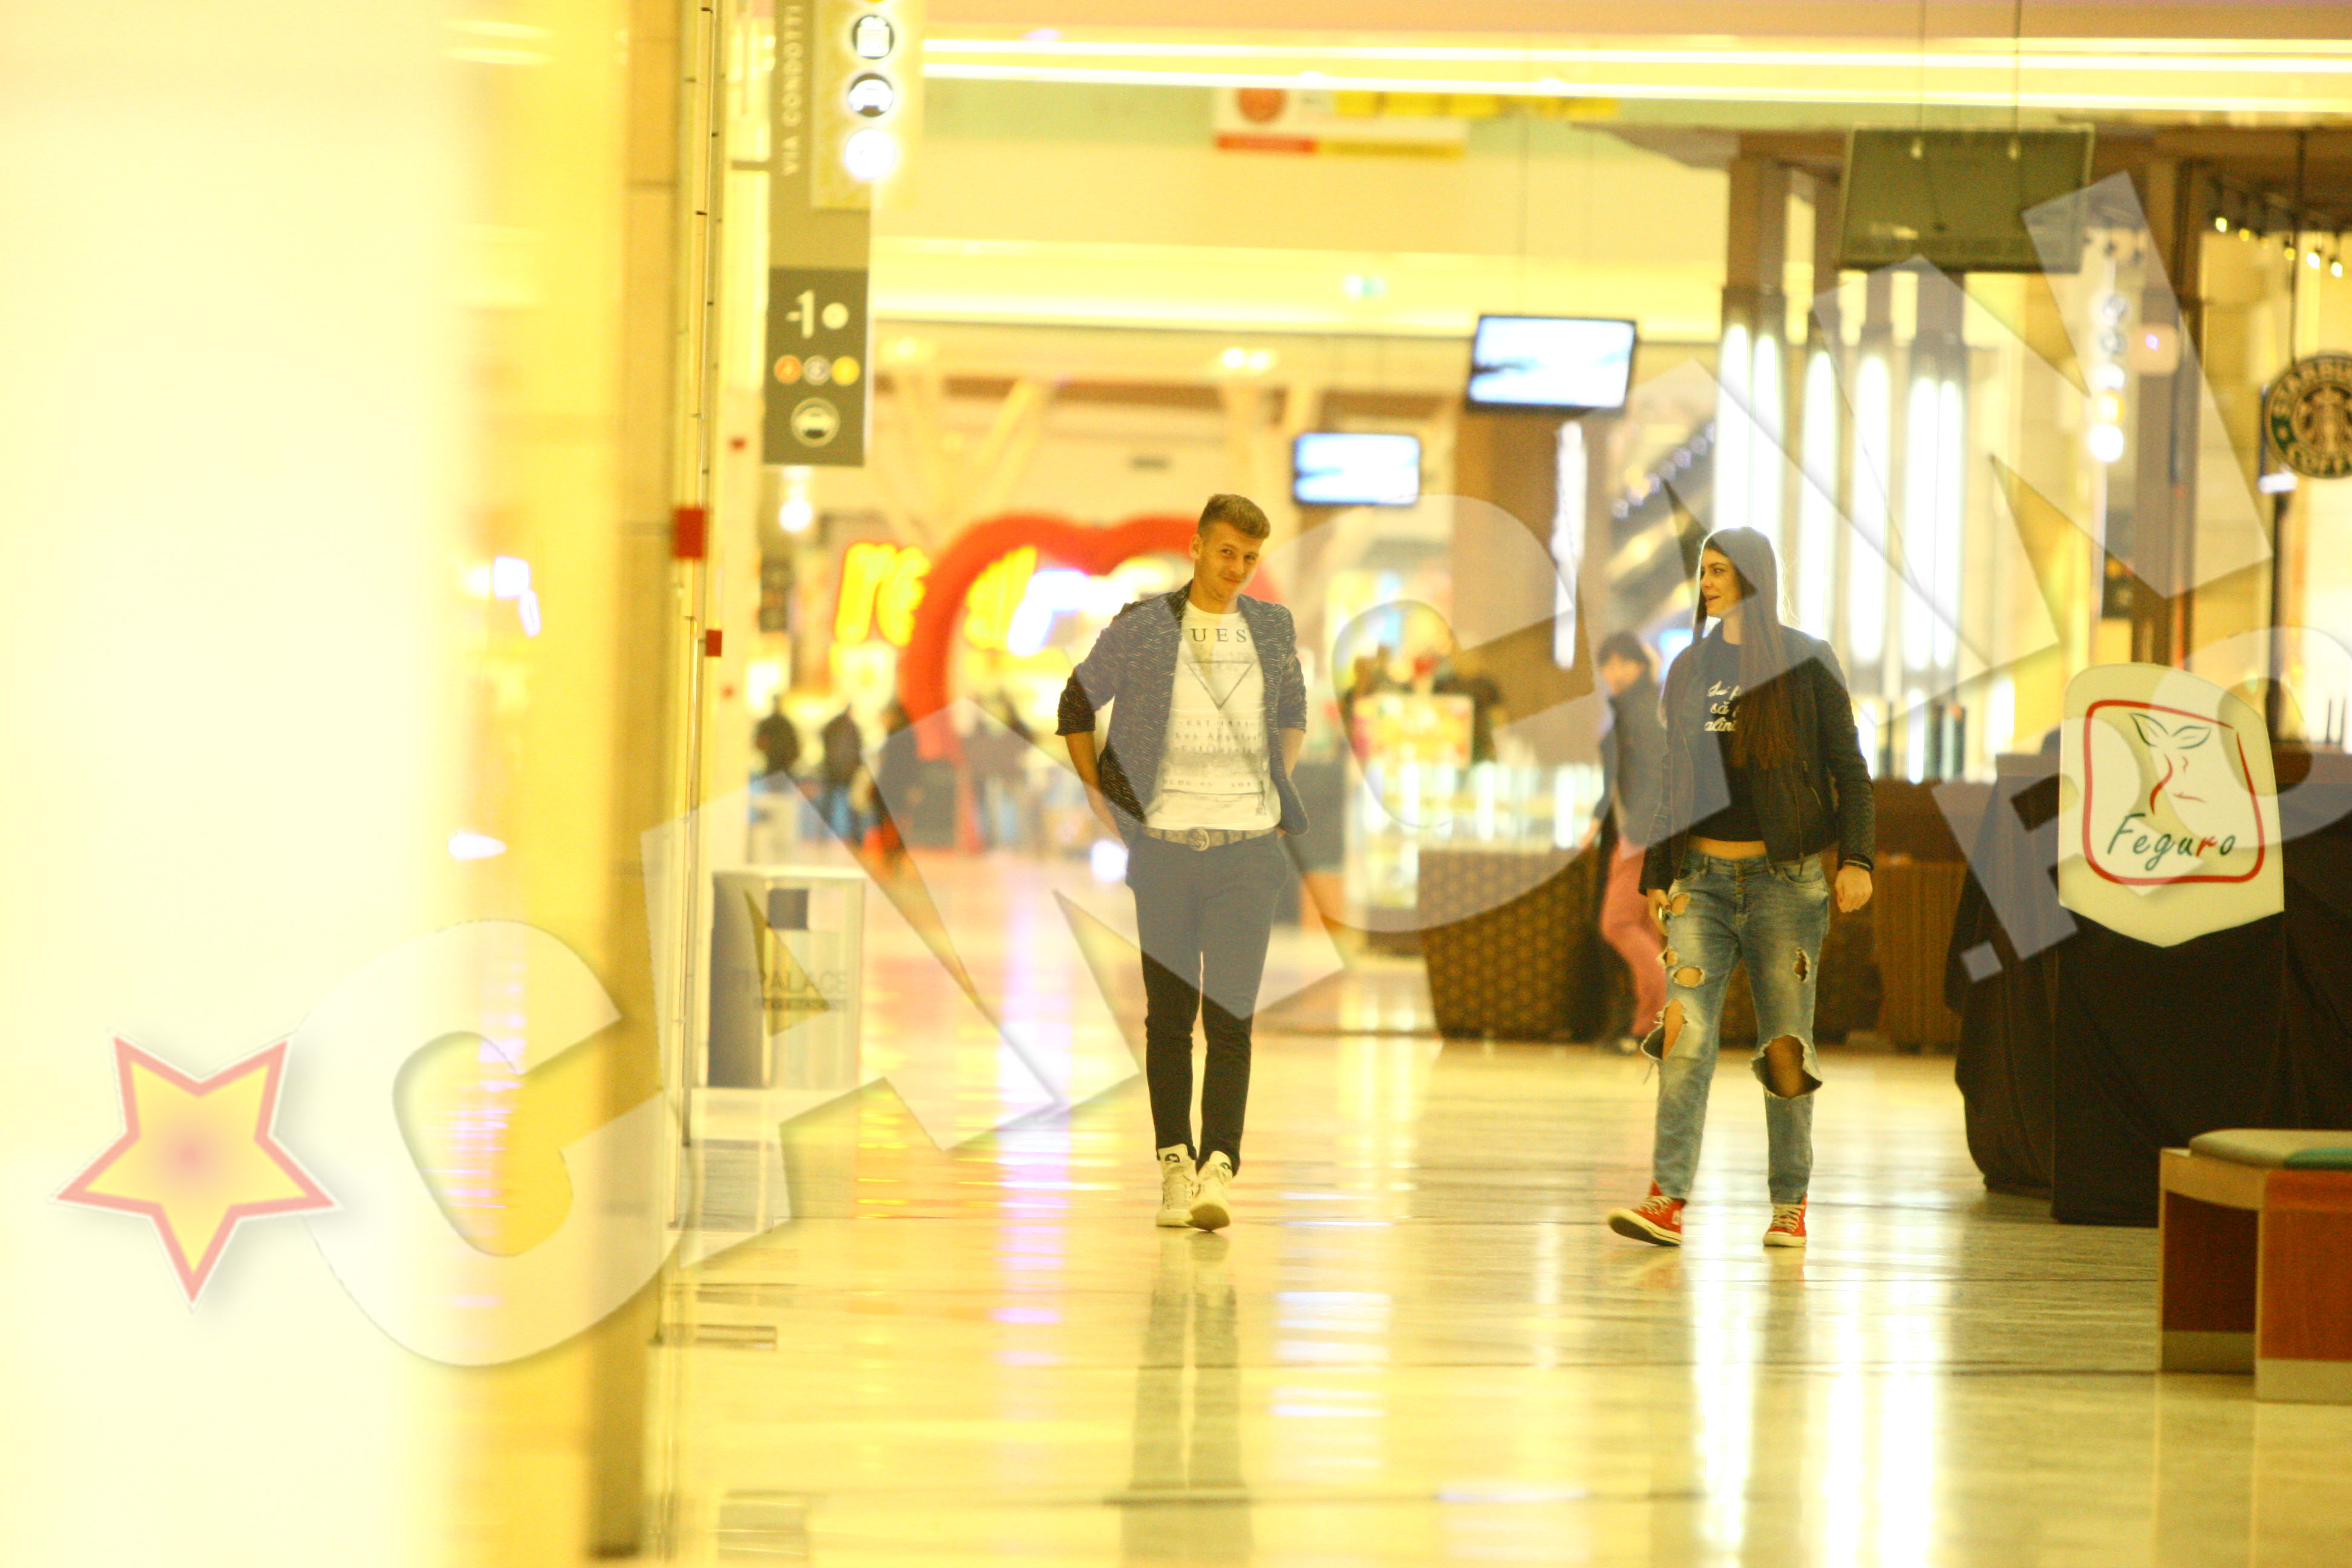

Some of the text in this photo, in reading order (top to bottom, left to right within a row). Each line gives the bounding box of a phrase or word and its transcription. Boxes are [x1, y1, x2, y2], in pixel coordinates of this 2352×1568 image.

[782, 5, 804, 175] VIA CONDOTTI
[2106, 814, 2236, 871] Feguro
